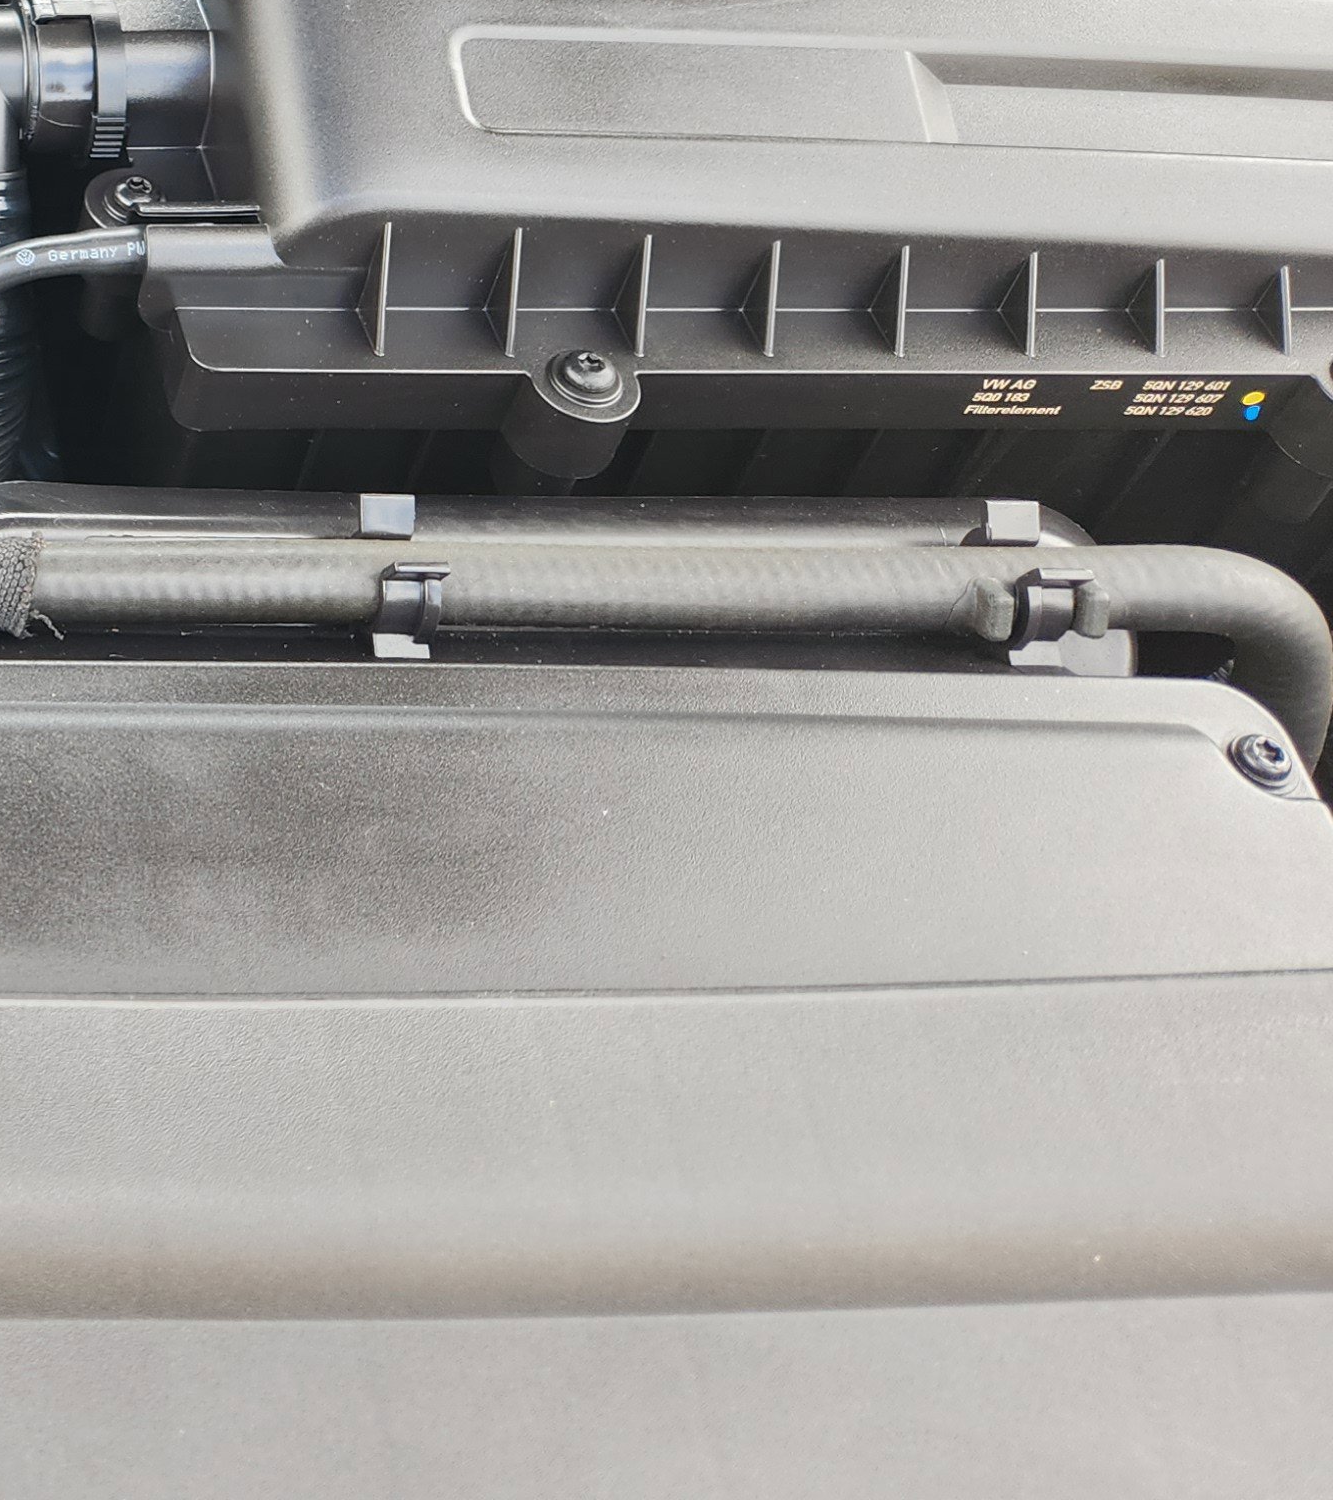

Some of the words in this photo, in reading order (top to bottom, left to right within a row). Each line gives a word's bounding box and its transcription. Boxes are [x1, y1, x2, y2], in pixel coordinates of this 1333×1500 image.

[47, 246, 118, 262] Germany
[982, 379, 1011, 390] VW
[1009, 379, 1037, 390] AG
[1089, 380, 1124, 390] ZSB
[1142, 380, 1176, 391] 5QN
[1178, 380, 1205, 391] 129
[1204, 380, 1231, 391] 601
[1004, 392, 1030, 402] 183
[1133, 393, 1166, 404] 5QN
[1168, 393, 1195, 403] 129
[1195, 393, 1225, 404] 607
[963, 404, 1062, 416] Filterelement
[1123, 406, 1157, 416] 5QN
[1159, 406, 1186, 416] 129
[1185, 406, 1214, 416] 620
